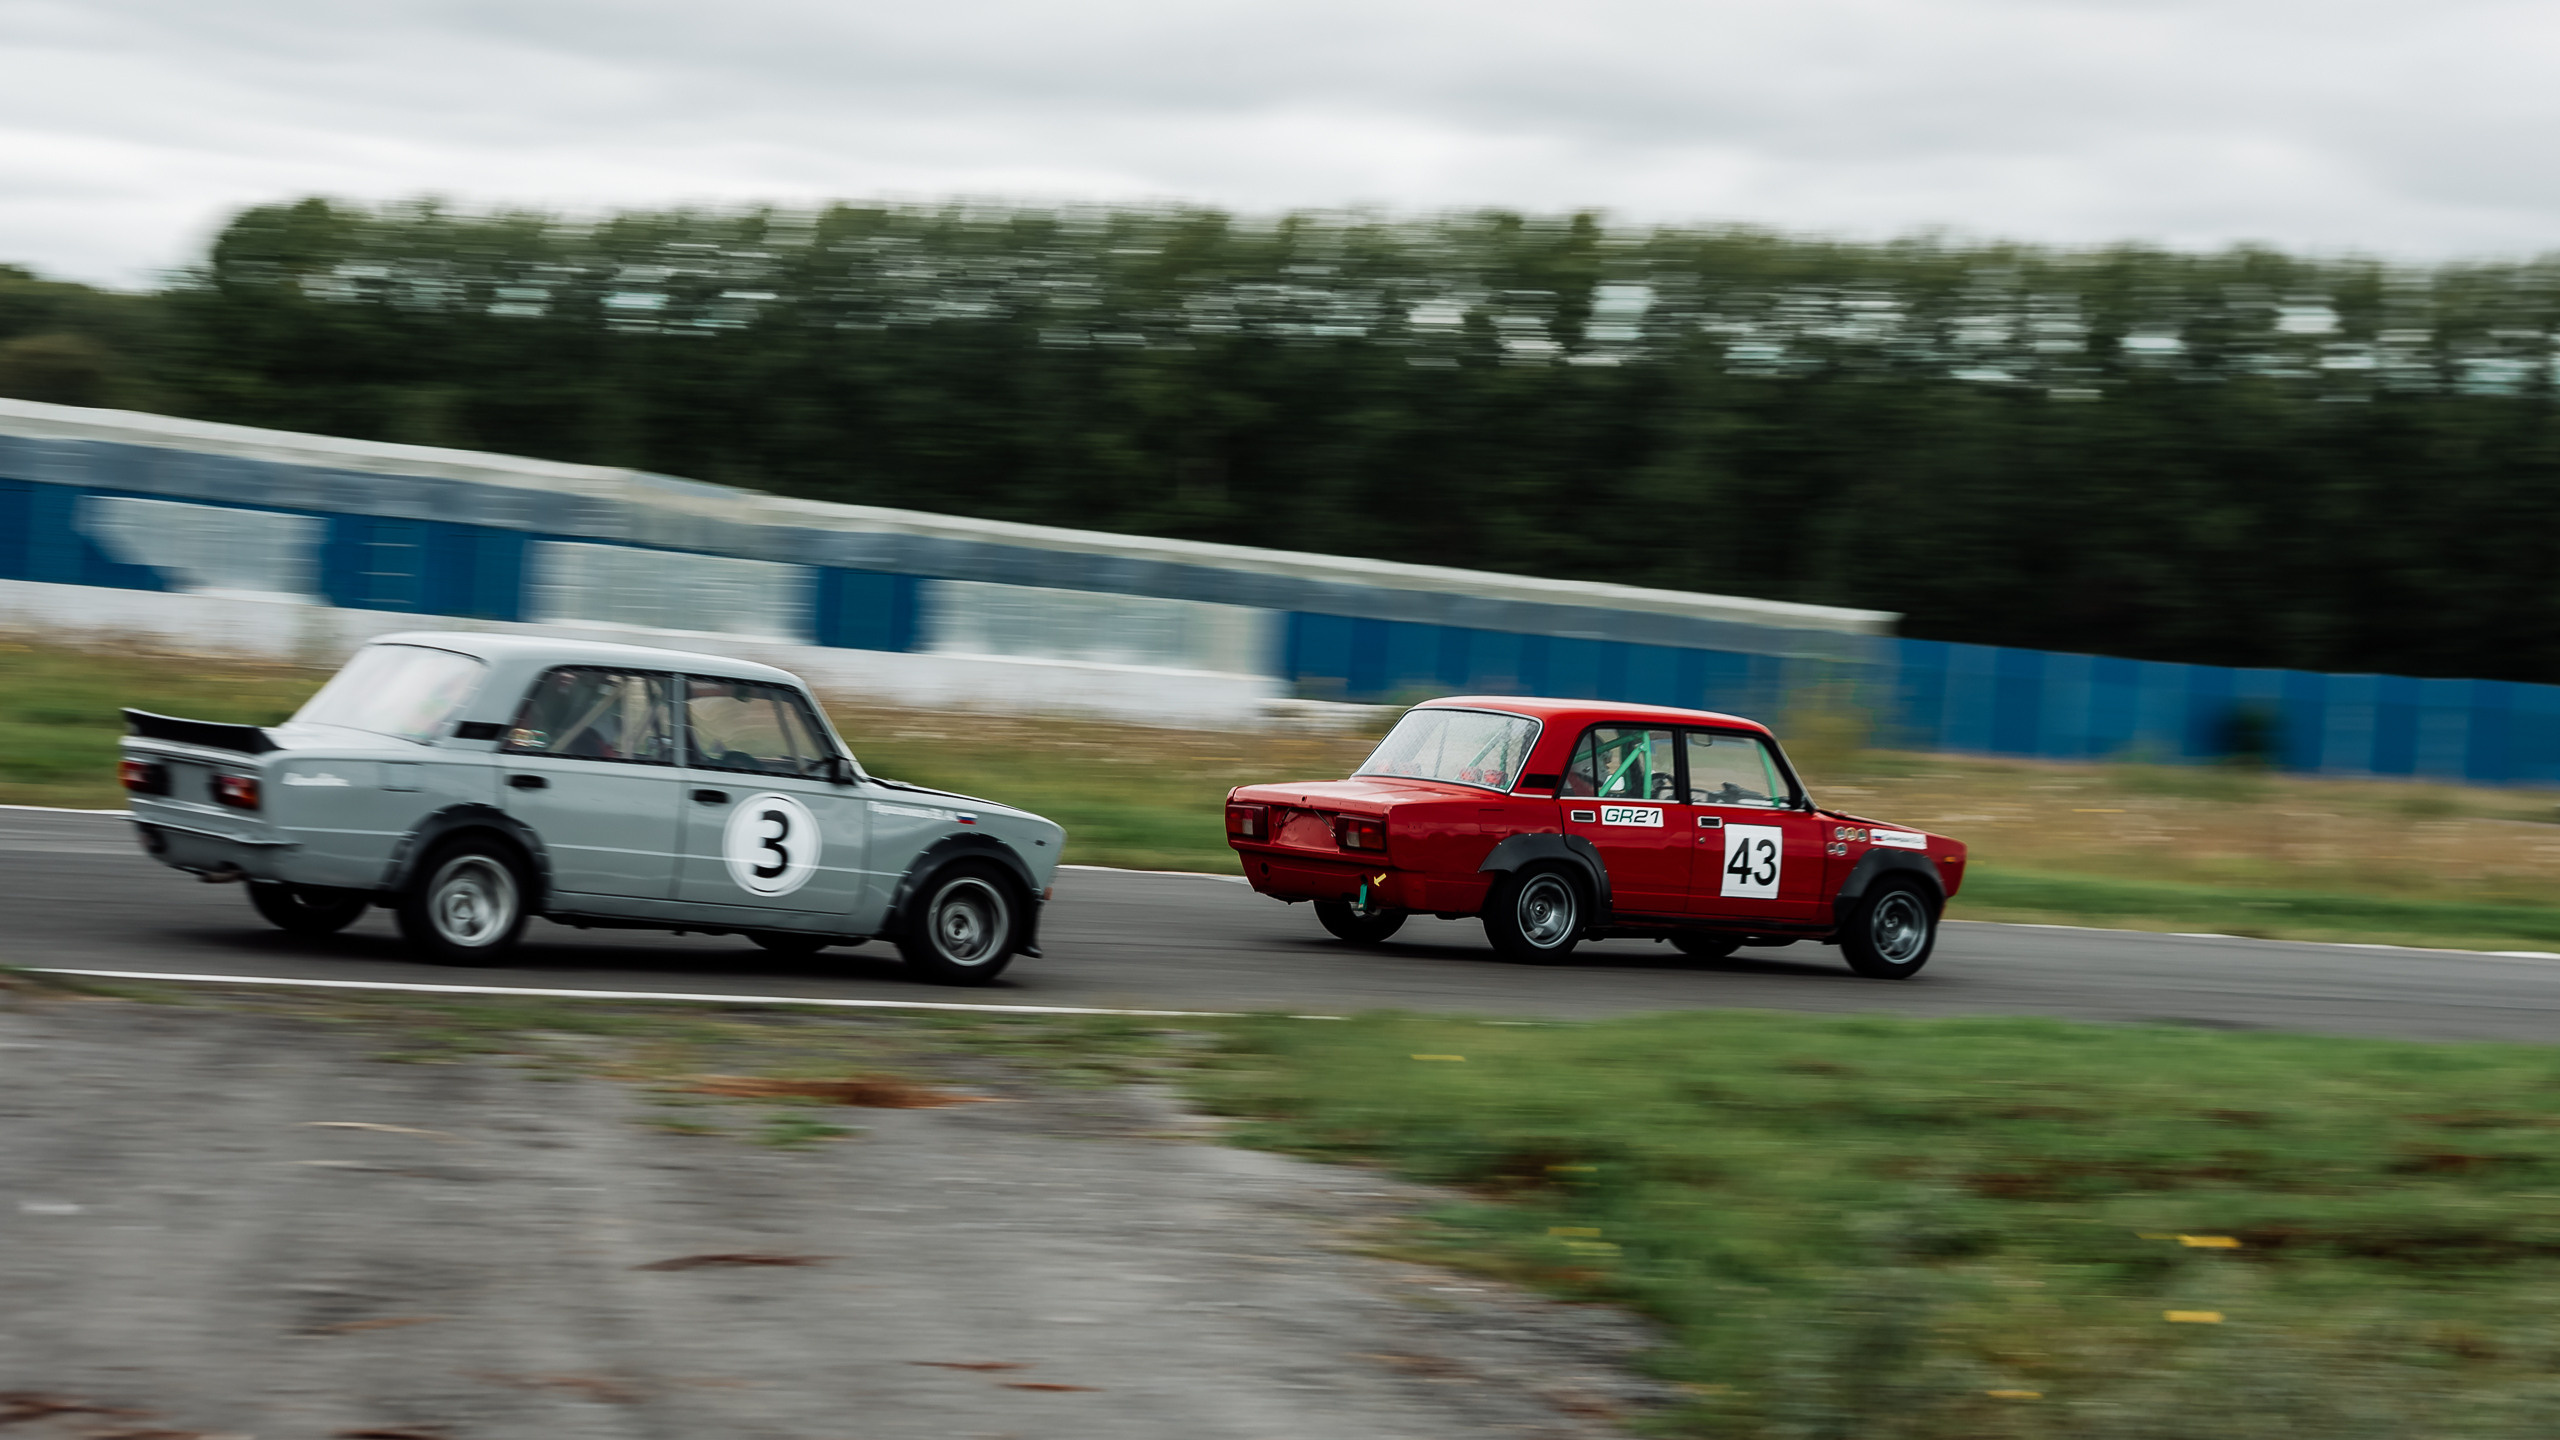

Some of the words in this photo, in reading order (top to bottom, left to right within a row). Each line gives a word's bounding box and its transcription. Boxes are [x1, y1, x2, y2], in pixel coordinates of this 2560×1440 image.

[1605, 808, 1660, 824] GR21
[752, 809, 790, 878] 3
[1727, 837, 1776, 886] 43
